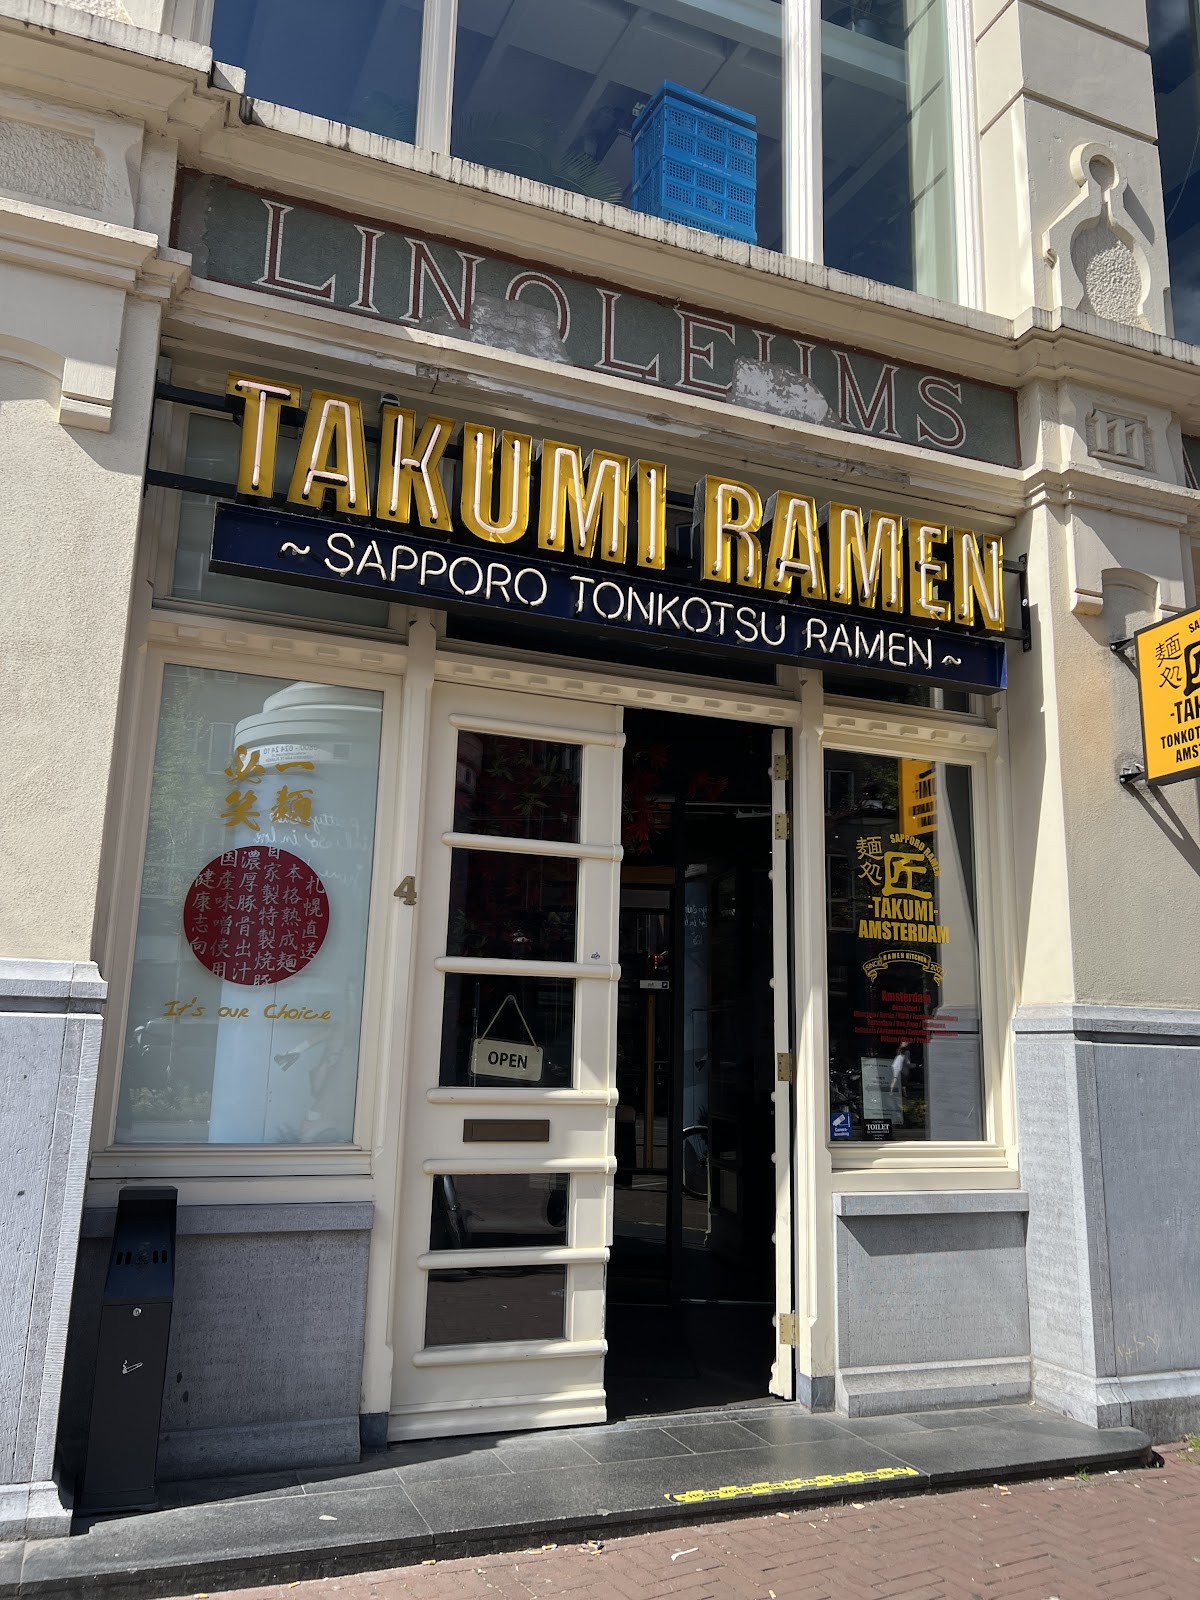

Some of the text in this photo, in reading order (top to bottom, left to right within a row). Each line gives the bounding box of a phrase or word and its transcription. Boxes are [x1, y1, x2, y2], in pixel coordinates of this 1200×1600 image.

[226, 370, 1004, 631] TAKUMI RAMEN
[324, 532, 548, 607] SAPPORO
[570, 575, 787, 646] TONKOTSU
[805, 618, 933, 669] RAMEN
[1176, 744, 1200, 763] AMS
[890, 833, 925, 851] SAPPORO
[393, 875, 417, 906] 4
[882, 851, 932, 899] 匠
[190, 868, 216, 956] 健康志向
[232, 849, 261, 981] 濃厚豚骨出汁
[300, 875, 325, 960] 札幌直送
[858, 919, 949, 944] AMSTERDAM
[263, 1003, 331, 1020] Choice
[487, 1050, 528, 1069] OPEN
[866, 1123, 890, 1131] TOILET
